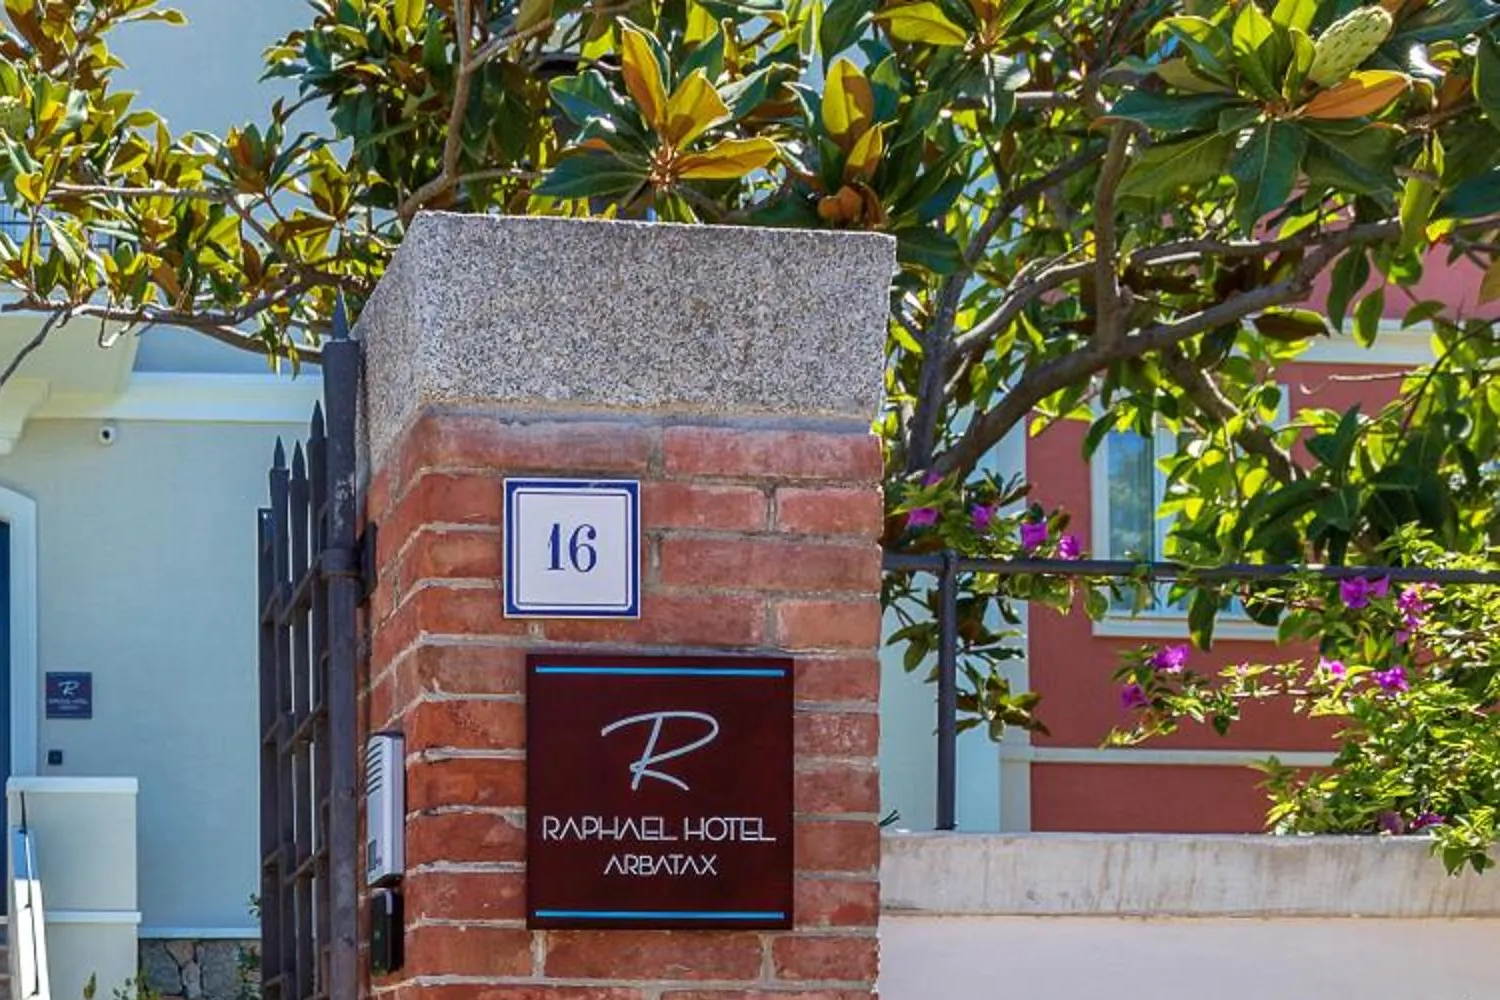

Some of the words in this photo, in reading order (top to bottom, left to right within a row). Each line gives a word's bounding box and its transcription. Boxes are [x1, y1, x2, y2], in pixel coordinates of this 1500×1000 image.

[548, 523, 597, 573] 16
[601, 711, 719, 791] R
[542, 816, 678, 841] RAPHAEL
[684, 817, 777, 841] HOTEL
[604, 854, 717, 876] ARBATAX
